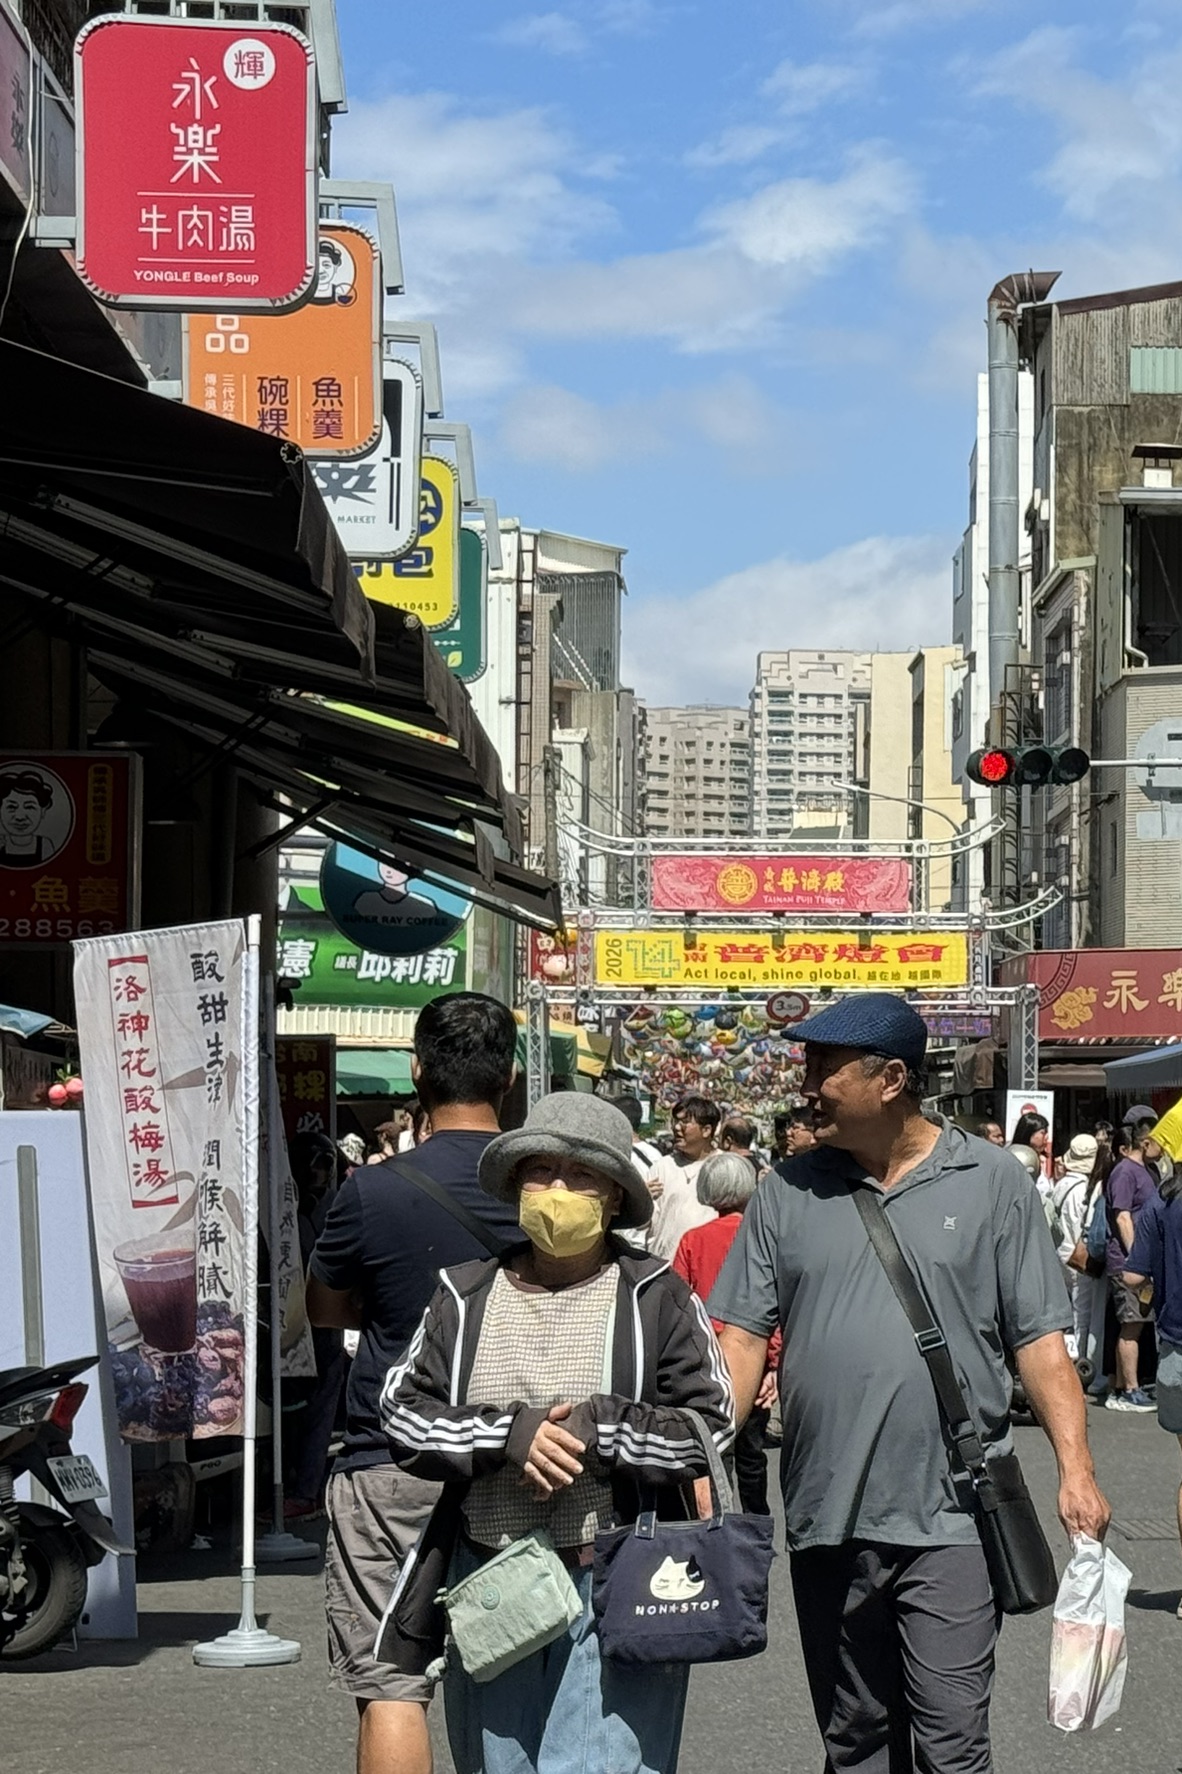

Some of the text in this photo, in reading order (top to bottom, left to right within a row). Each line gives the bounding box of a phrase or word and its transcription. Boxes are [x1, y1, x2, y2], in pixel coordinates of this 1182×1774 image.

[233, 51, 266, 80] 輝
[138, 205, 256, 251] 牛肉湯
[133, 270, 260, 286] YONGLE Beef Soup
[257, 375, 290, 438] 碗粿
[311, 377, 344, 440] 魚羹
[337, 516, 377, 524] MARKET
[389, 602, 438, 611] 110453
[30, 875, 119, 914] 魚羹
[763, 895, 794, 904] TAINAN
[343, 914, 449, 926] SUPER RAY COFFEE
[276, 938, 316, 977] 憲
[605, 938, 622, 978] 2026
[683, 967, 709, 979] Act
[715, 967, 757, 981] local,
[762, 967, 804, 980] shine
[190, 951, 228, 1111] 酸甜生津
[113, 975, 169, 1188] 洛神花酸梅湯
